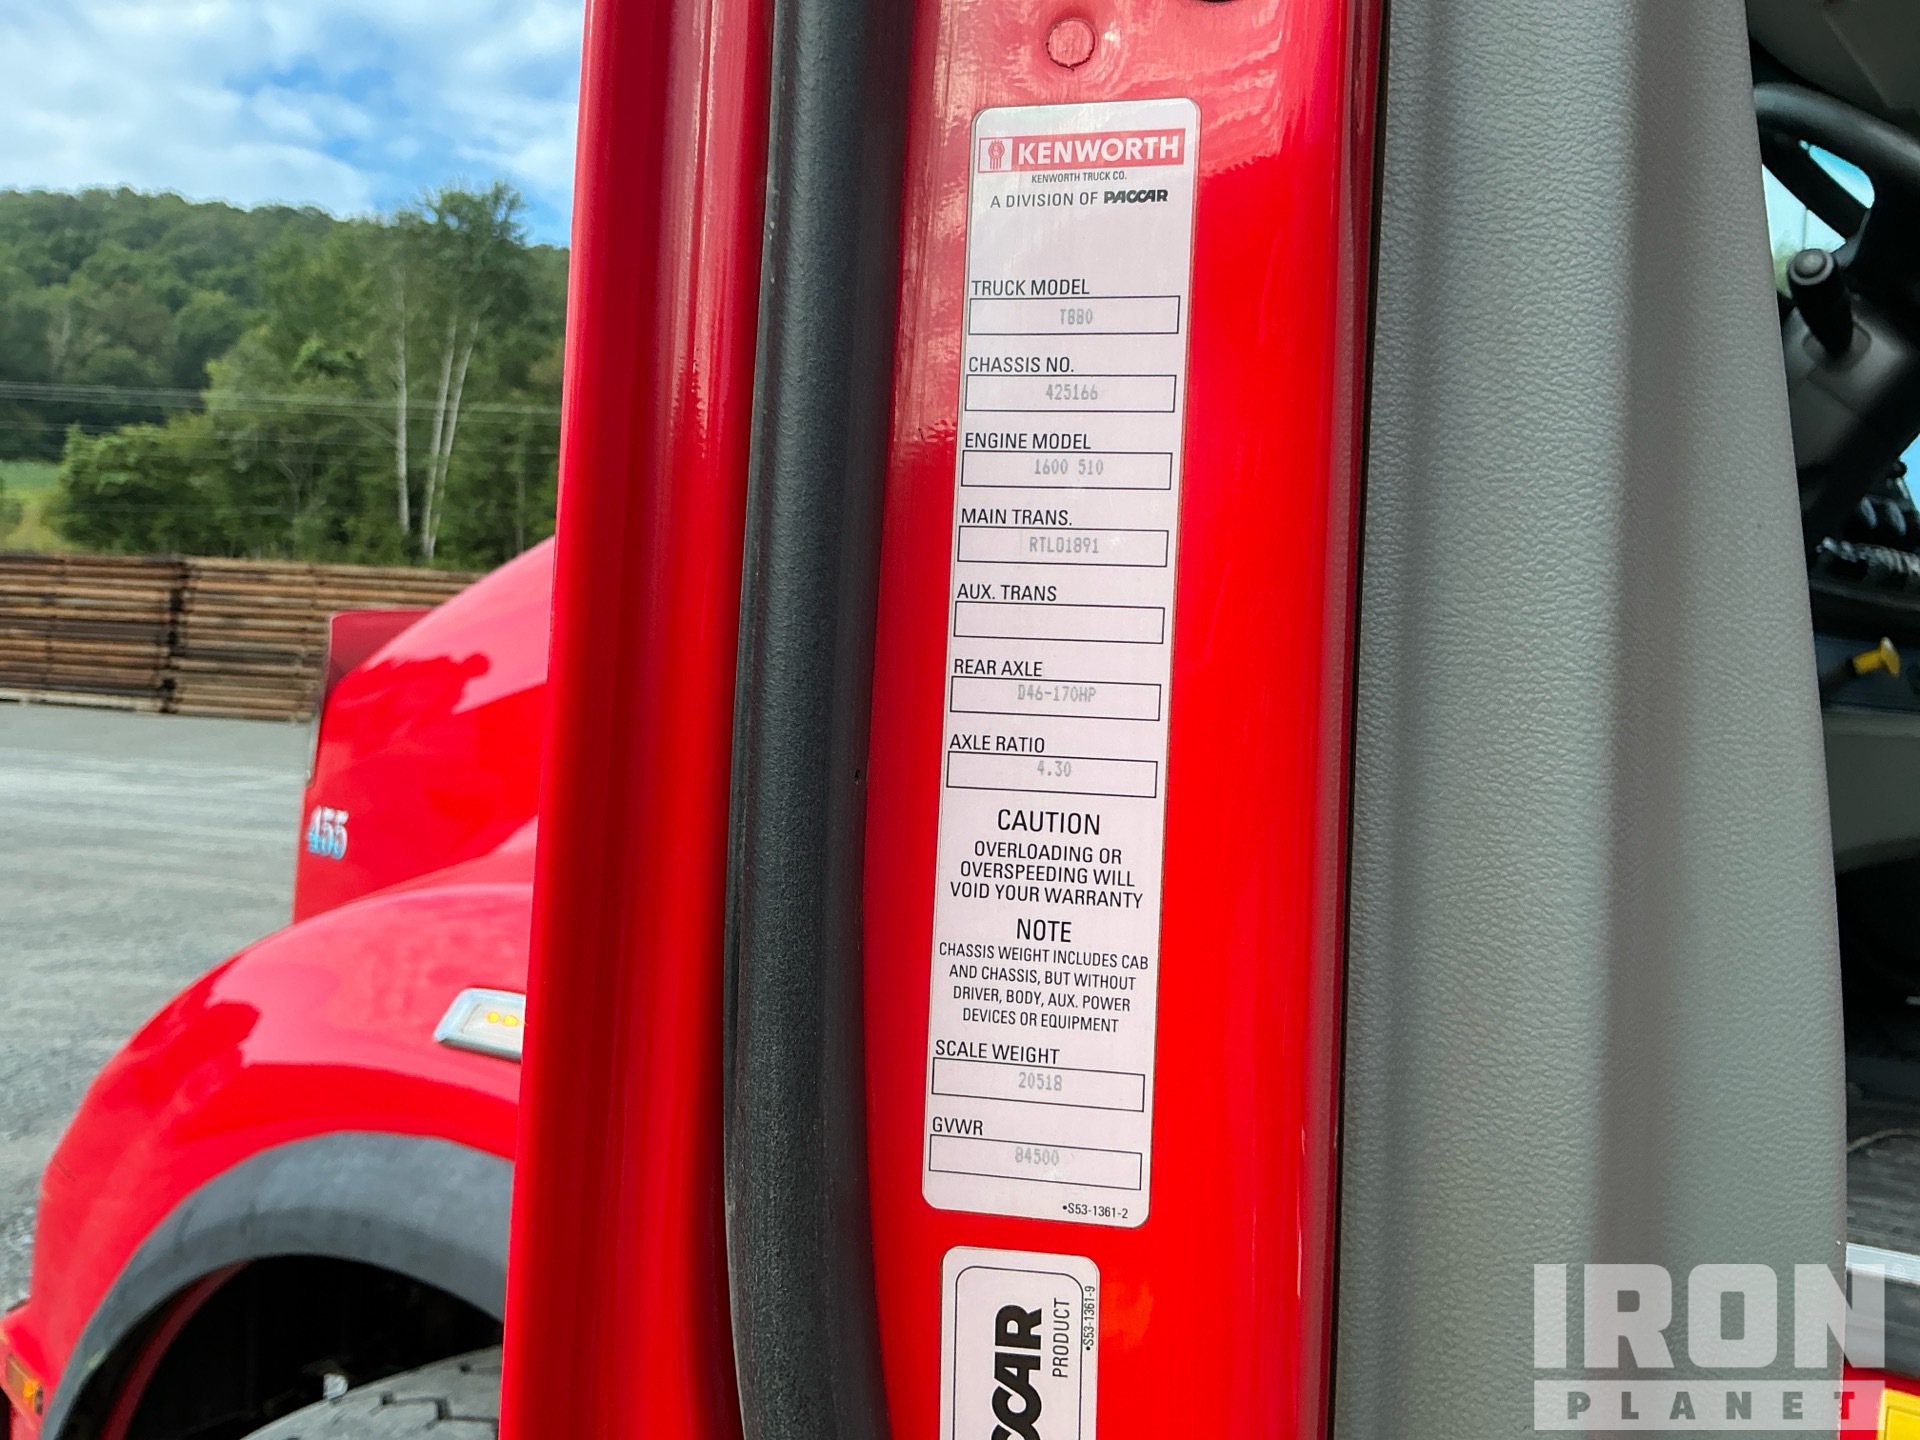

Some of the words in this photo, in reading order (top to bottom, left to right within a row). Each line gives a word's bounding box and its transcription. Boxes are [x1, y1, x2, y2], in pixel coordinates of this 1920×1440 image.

[1018, 135, 1179, 165] KENWORTH
[1031, 173, 1081, 184] KENWORTH
[1083, 172, 1111, 182] TRUCK
[1112, 171, 1127, 181] CO.
[991, 195, 1000, 208] A
[1006, 193, 1074, 208] DIVISION
[1080, 192, 1098, 205] OF
[1103, 189, 1168, 204] PACCAR
[971, 280, 1025, 296] TRUCK
[1031, 279, 1090, 295] MODEL
[1060, 308, 1093, 325] T880
[968, 357, 1041, 372] CHASSIS
[1046, 357, 1074, 373] NO.
[1045, 384, 1099, 400] 425166
[965, 433, 1028, 449] ENGINE
[1032, 433, 1091, 450] MODEL
[1034, 459, 1069, 475] 1600
[1078, 459, 1104, 475] 510
[961, 508, 1007, 525] MAIN
[1012, 509, 1073, 526] TRANS.
[956, 584, 996, 600] AUX.
[1000, 585, 1057, 602] TRANS
[954, 658, 997, 675] REAR
[1001, 660, 1043, 677] AXLE
[1017, 684, 1097, 702] D46-170HP
[949, 734, 991, 751] AXLE
[996, 736, 1045, 753] RATIO
[1037, 760, 1072, 777] 4.30
[997, 809, 1100, 835] CAUTION
[974, 840, 1093, 863] OVERLOADING
[1099, 847, 1122, 865] OR
[960, 860, 1088, 884] OVERSPEEDING
[1093, 869, 1135, 887] WILL
[950, 881, 990, 899] VOID
[995, 884, 1039, 902] YOUR
[1044, 887, 1143, 909] WARRANTY
[1016, 918, 1072, 943] NOTE
[939, 942, 995, 959] CHASSIS
[998, 945, 1050, 963] WEIGHT
[1053, 950, 1118, 968] INCLUDES
[1121, 955, 1149, 970] CAB
[949, 964, 977, 979] AND
[981, 967, 1041, 986] CHASSIS,
[1044, 971, 1070, 985] BUT
[1074, 973, 1136, 991] WITHOUT
[953, 986, 1003, 1004] DRIVER,
[1006, 990, 1045, 1008] BODY,
[1048, 993, 1079, 1009] AUX.
[1082, 996, 1131, 1012] POWER
[963, 1007, 1016, 1025] DEVICES
[1020, 1012, 1037, 1027] OR
[1041, 1014, 1119, 1033] EQUIPMENT
[935, 1039, 988, 1059] SCALE
[992, 1044, 1060, 1064] WEIGHT
[1018, 1072, 1063, 1092] 20518
[932, 1116, 984, 1136] GVWR
[1014, 1146, 1059, 1166] 84500
[1052, 1297, 1070, 1378] PRODUCT
